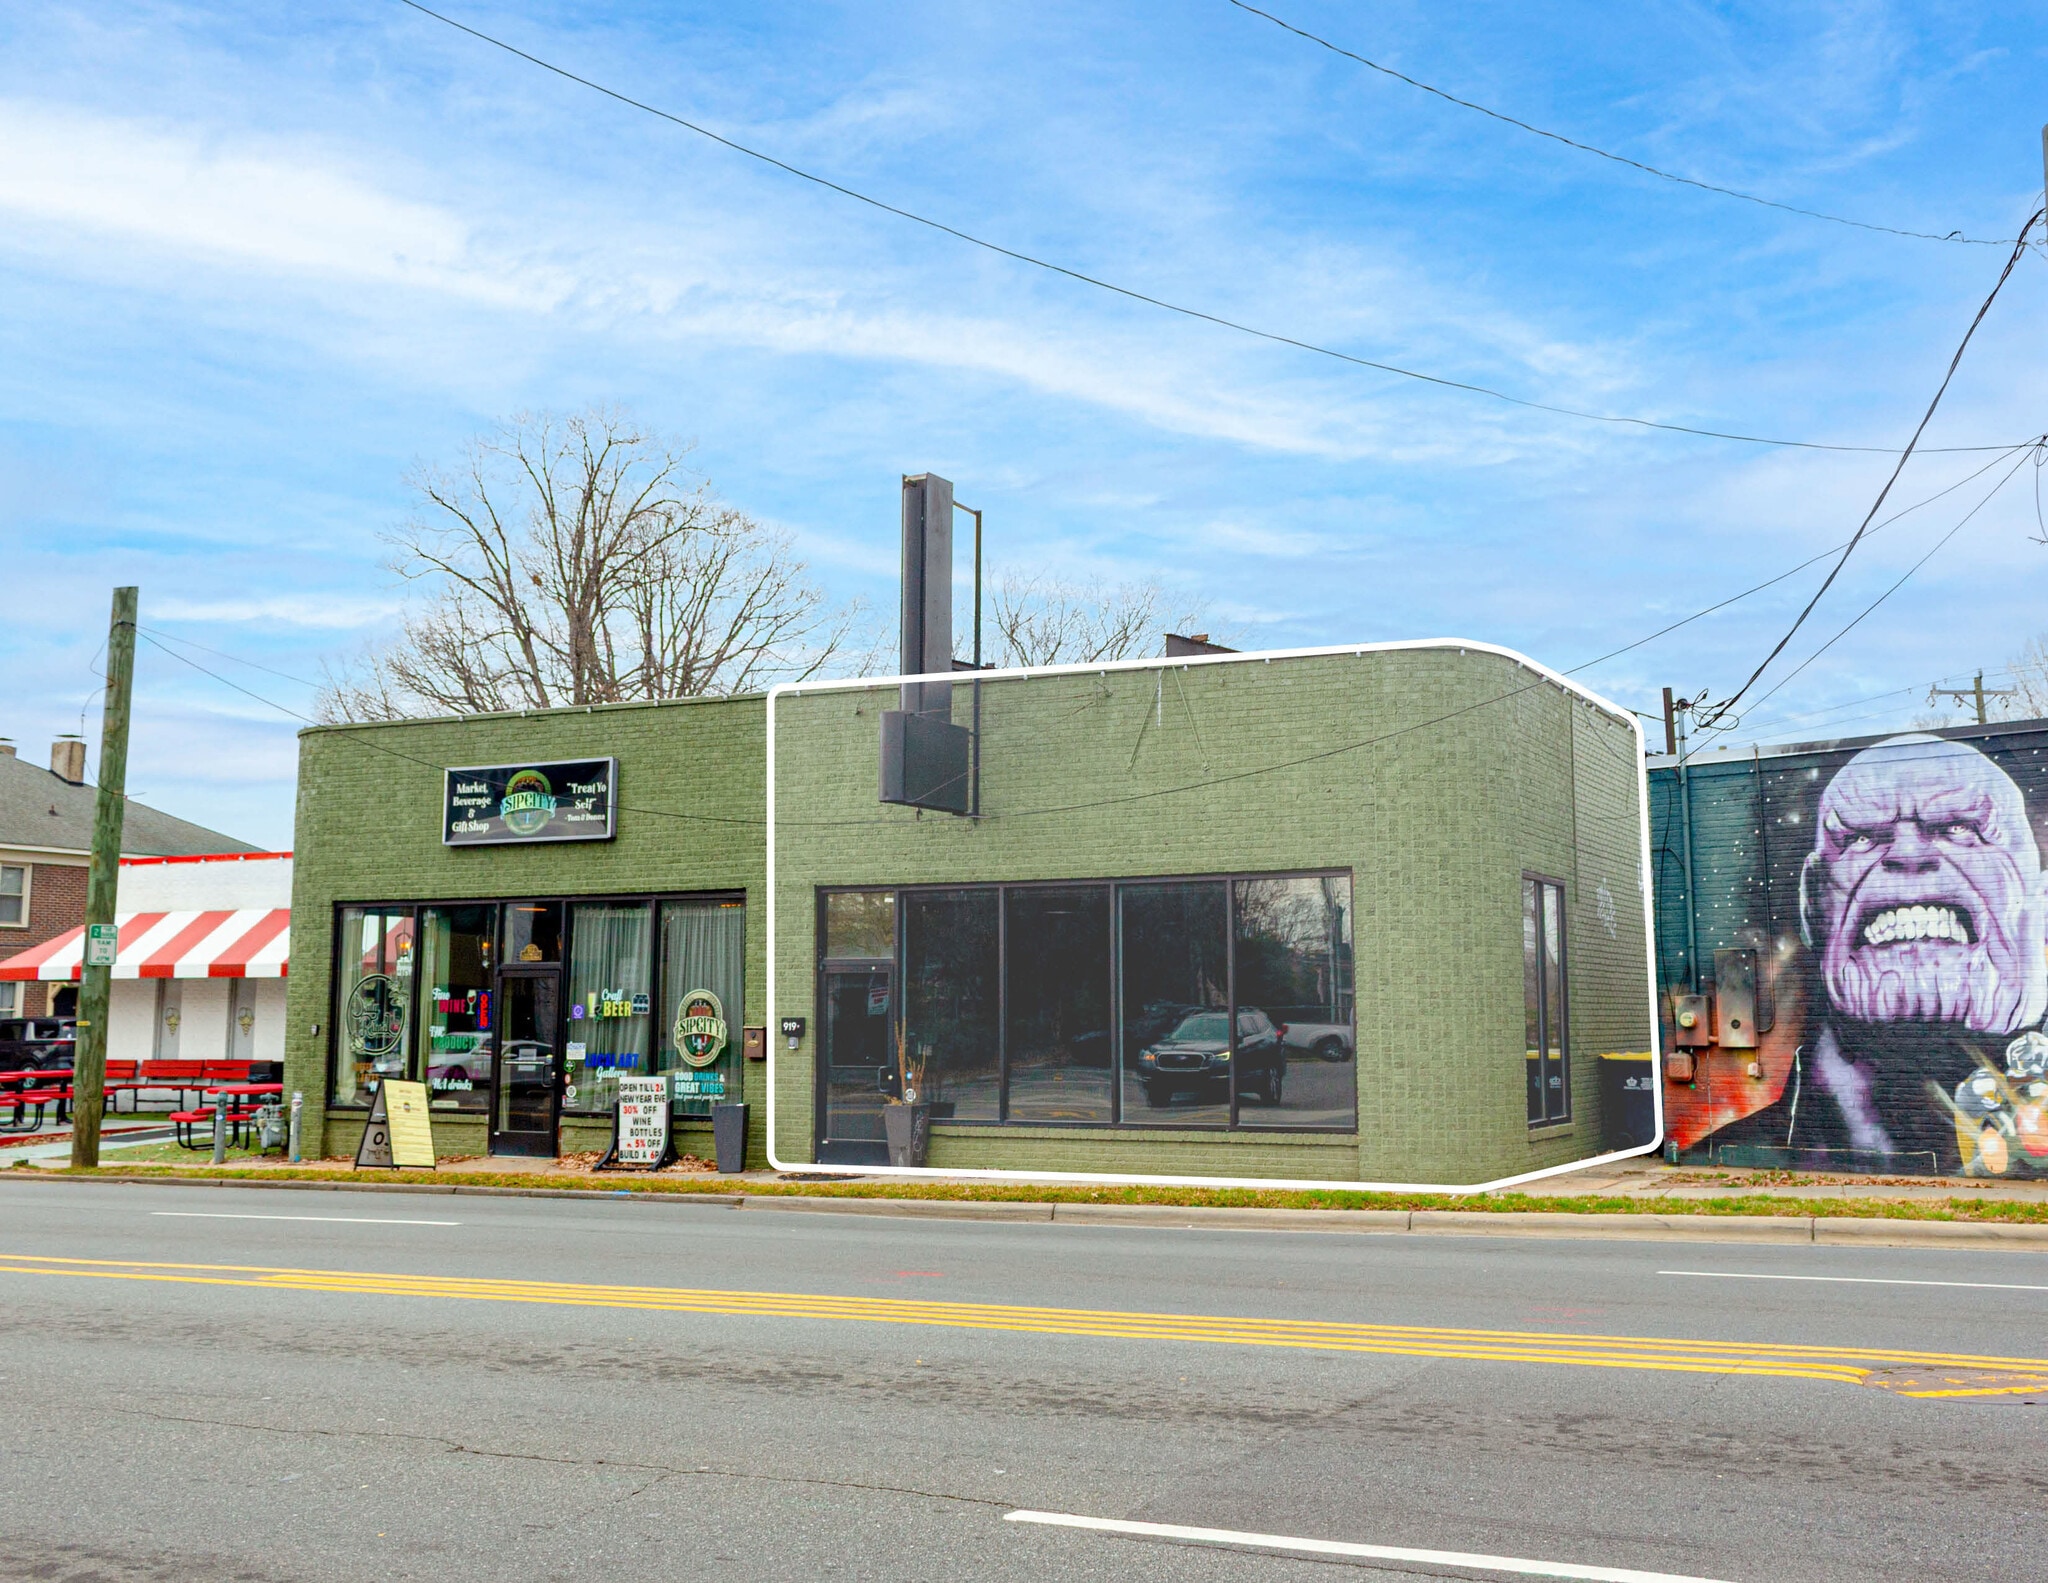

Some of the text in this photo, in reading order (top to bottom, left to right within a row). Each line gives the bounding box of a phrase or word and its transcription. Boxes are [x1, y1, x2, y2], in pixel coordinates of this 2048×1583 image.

[452, 796, 492, 809] Beverage
[504, 792, 553, 812] SIPCITY
[586, 813, 606, 821] Donna
[451, 820, 490, 834] Gift Shop
[601, 988, 624, 1004] Craft
[438, 998, 466, 1014] WINE
[479, 993, 489, 1028] OPEN
[603, 1001, 632, 1017] BEER
[679, 1016, 723, 1038] SIPCITY
[782, 1021, 797, 1031] 919
[585, 1053, 616, 1068] LOCAL
[618, 1053, 639, 1068] ART
[674, 1071, 694, 1081] GOOD
[694, 1071, 719, 1082] DRINKS
[447, 1078, 473, 1092] drinks
[619, 1083, 638, 1092] OPEN
[639, 1083, 655, 1092] TILL
[674, 1082, 725, 1094] GREAT VIBES
[619, 1095, 634, 1103] NEW
[634, 1095, 653, 1103] YEAR
[654, 1094, 666, 1103] EVE
[623, 1105, 657, 1115] 30% OFF
[632, 1117, 652, 1126] WINE
[629, 1128, 663, 1137] BOTTLES
[646, 1139, 661, 1148] OFF
[619, 1150, 639, 1160] BUILD
[642, 1151, 647, 1160] A
